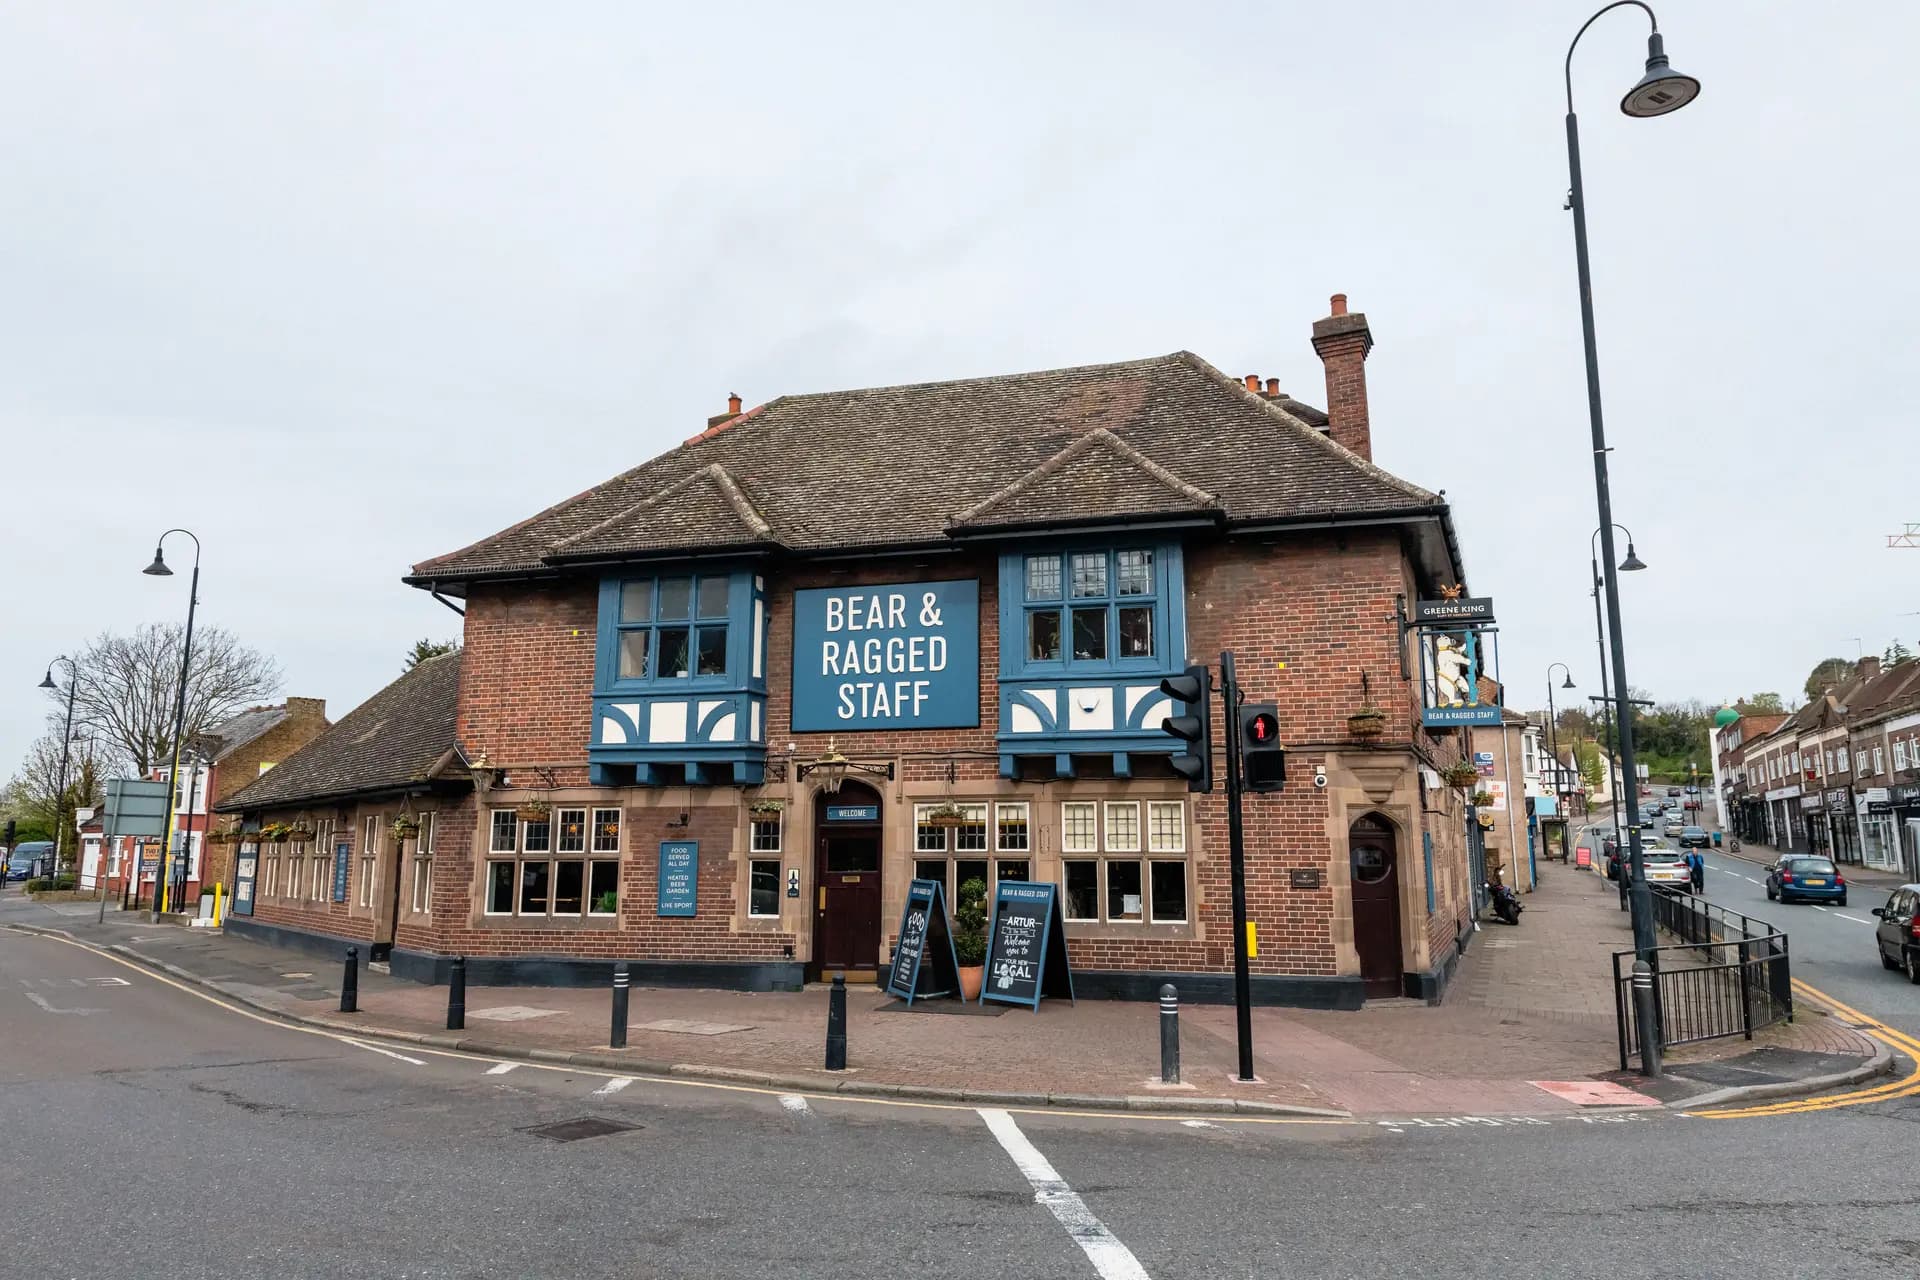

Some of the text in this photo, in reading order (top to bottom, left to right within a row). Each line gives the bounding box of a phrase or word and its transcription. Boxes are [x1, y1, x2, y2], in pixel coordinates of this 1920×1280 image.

[826, 592, 943, 632] BEAR &
[1423, 605, 1485, 615] GREENE KING
[822, 636, 947, 675] RAGGED
[838, 680, 930, 719] STAFF
[1428, 712, 1444, 720] BEAR
[1451, 711, 1475, 719] RAGGED
[1477, 711, 1494, 719] STAFF
[838, 809, 866, 817] WELCOME
[1001, 888, 1014, 896] BEAR
[1036, 890, 1049, 898] STAFF
[908, 911, 925, 932] FOOD
[1007, 916, 1036, 928] ARTUR
[1006, 946, 1028, 957] you to
